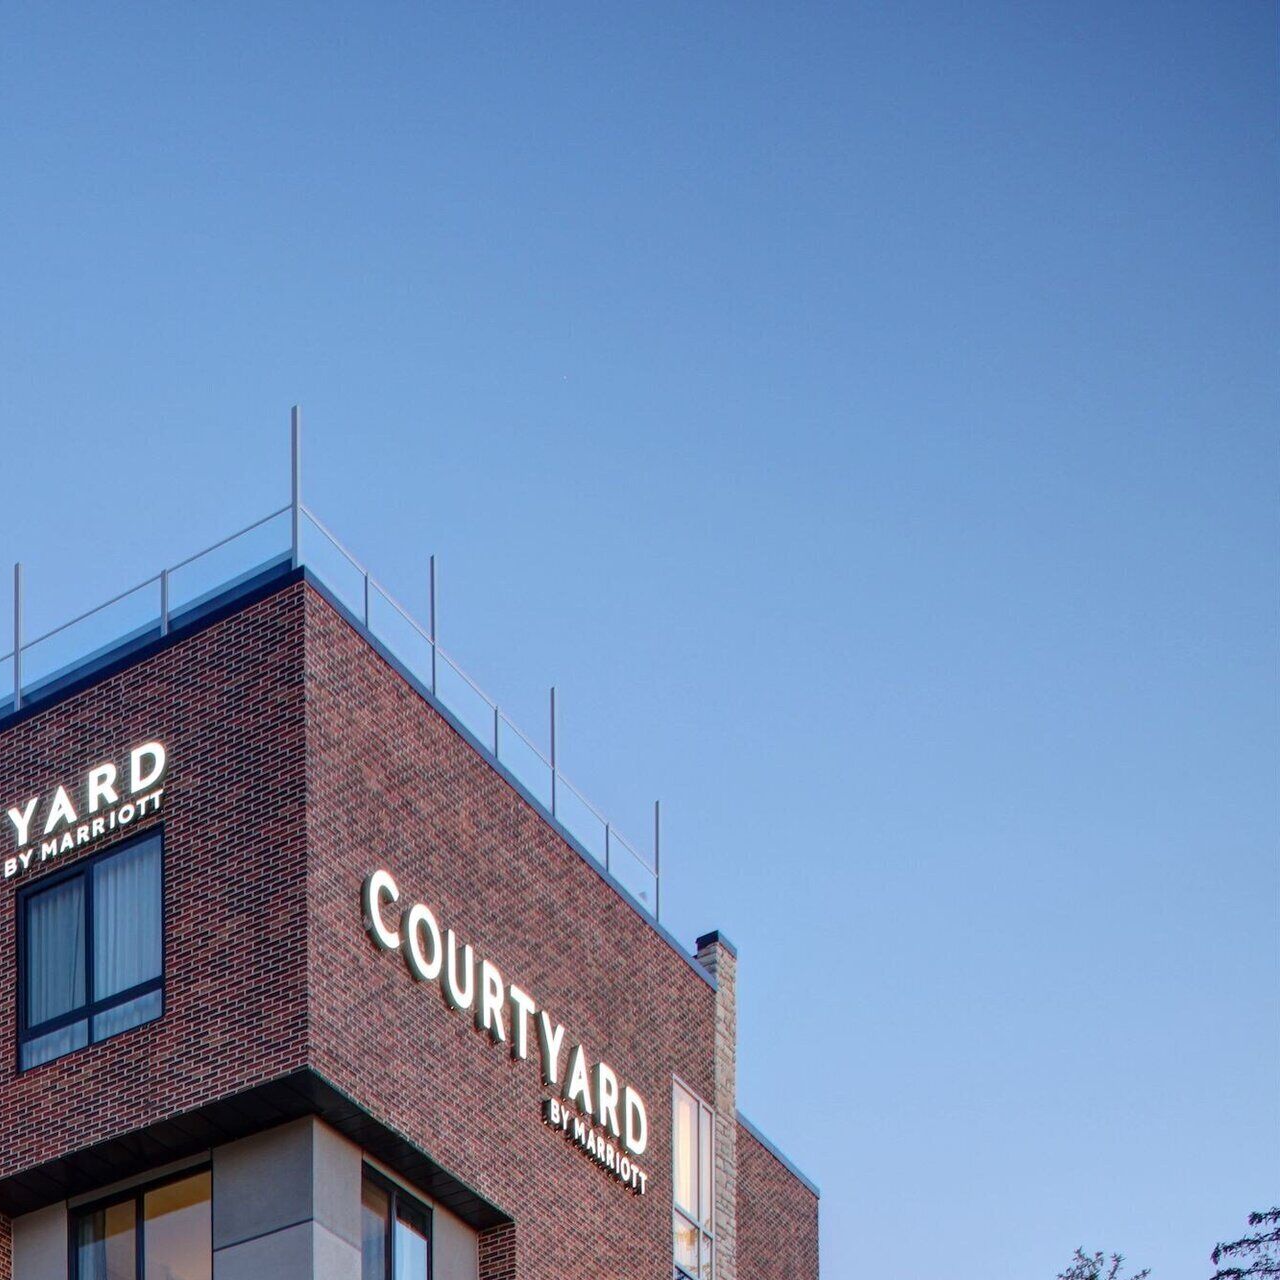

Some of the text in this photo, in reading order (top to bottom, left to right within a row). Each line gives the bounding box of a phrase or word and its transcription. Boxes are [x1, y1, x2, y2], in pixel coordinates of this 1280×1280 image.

[4, 788, 164, 878] BY MARRIOTT
[368, 869, 648, 1155] COURTYARD
[550, 1097, 648, 1195] BY MARRIOTT
